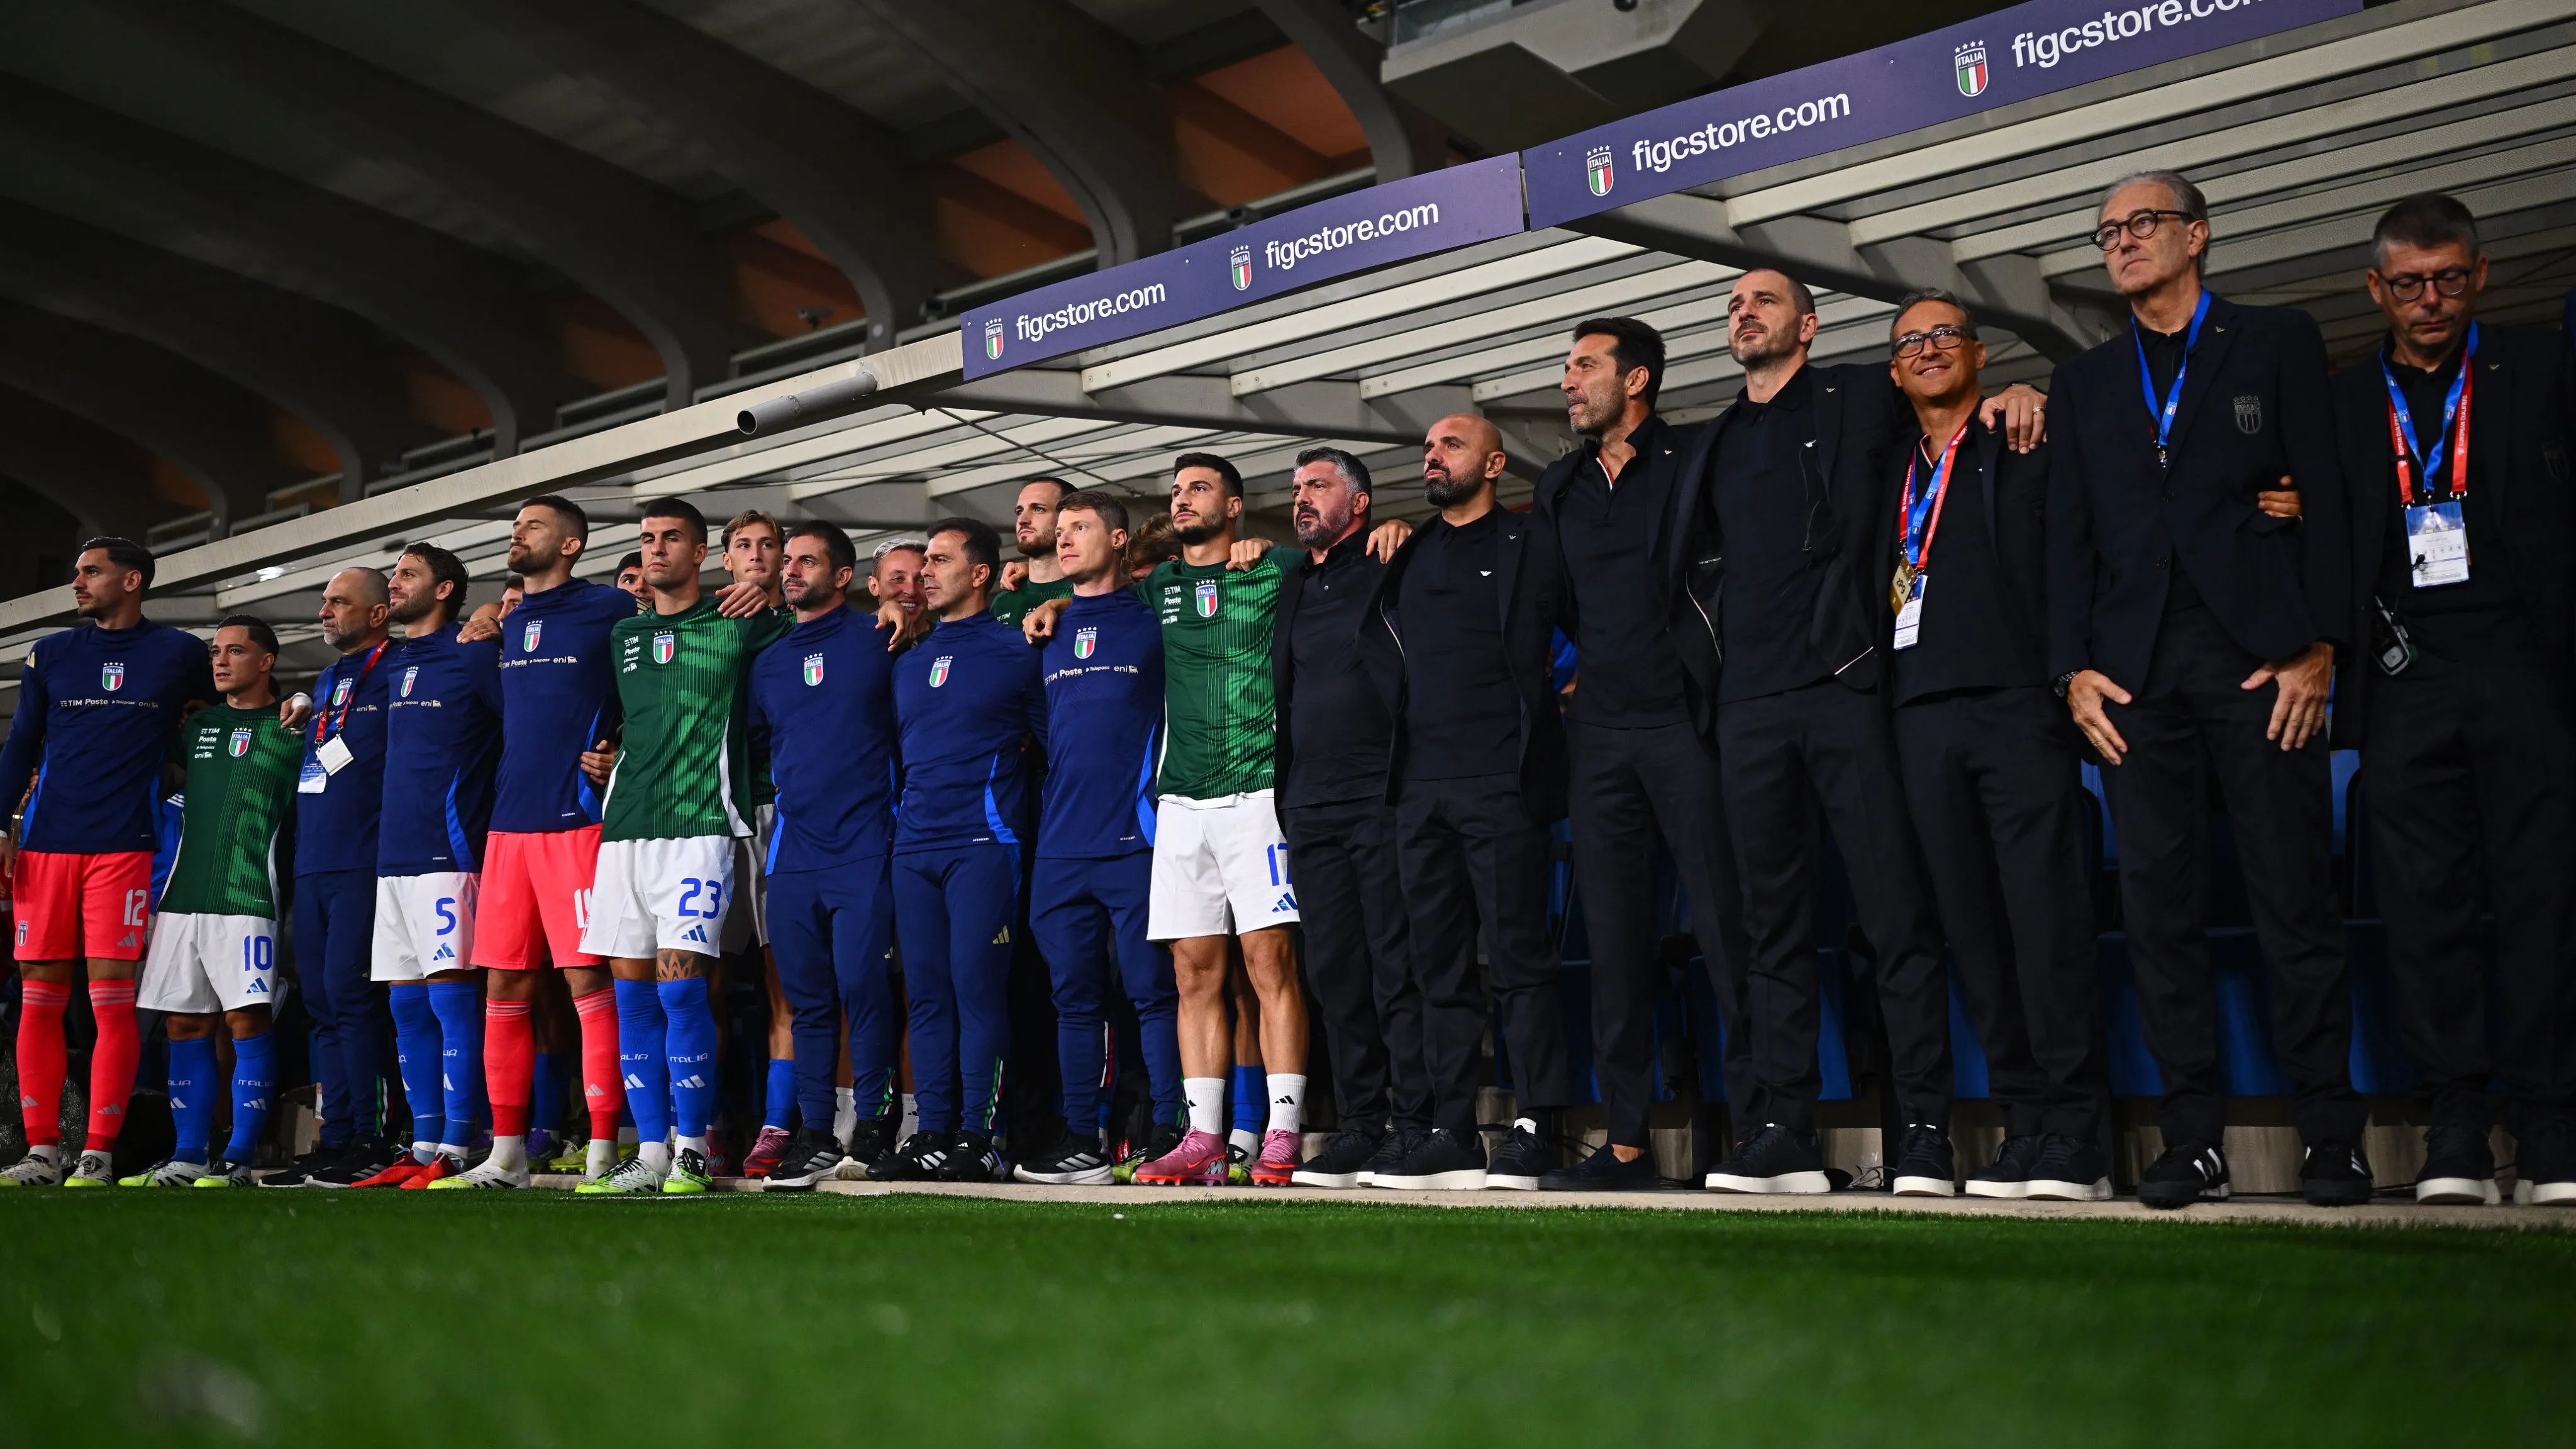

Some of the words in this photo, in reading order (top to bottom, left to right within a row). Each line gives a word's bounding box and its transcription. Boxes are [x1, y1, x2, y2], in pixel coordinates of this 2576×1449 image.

[2012, 0, 2263, 67] figcstore.c
[1957, 52, 1984, 65] ITALIA
[1632, 93, 1850, 172] figcstore.com
[1589, 156, 1609, 168] ITALIA
[1265, 203, 1439, 270] figcstore.com
[1233, 255, 1248, 265] ITALIA
[1016, 283, 1165, 342] figcstore.com
[987, 326, 1001, 336] ITALIA
[1170, 586, 1181, 594] TIM
[629, 636, 638, 645] TIM
[625, 647, 640, 655] Poste
[1048, 672, 1057, 682] TIM
[1060, 668, 1082, 677] Poste
[678, 878, 722, 919] 23
[124, 889, 147, 926] 12
[436, 897, 456, 936] 5
[244, 935, 272, 971] 10
[670, 1053, 708, 1063] ITALIA
